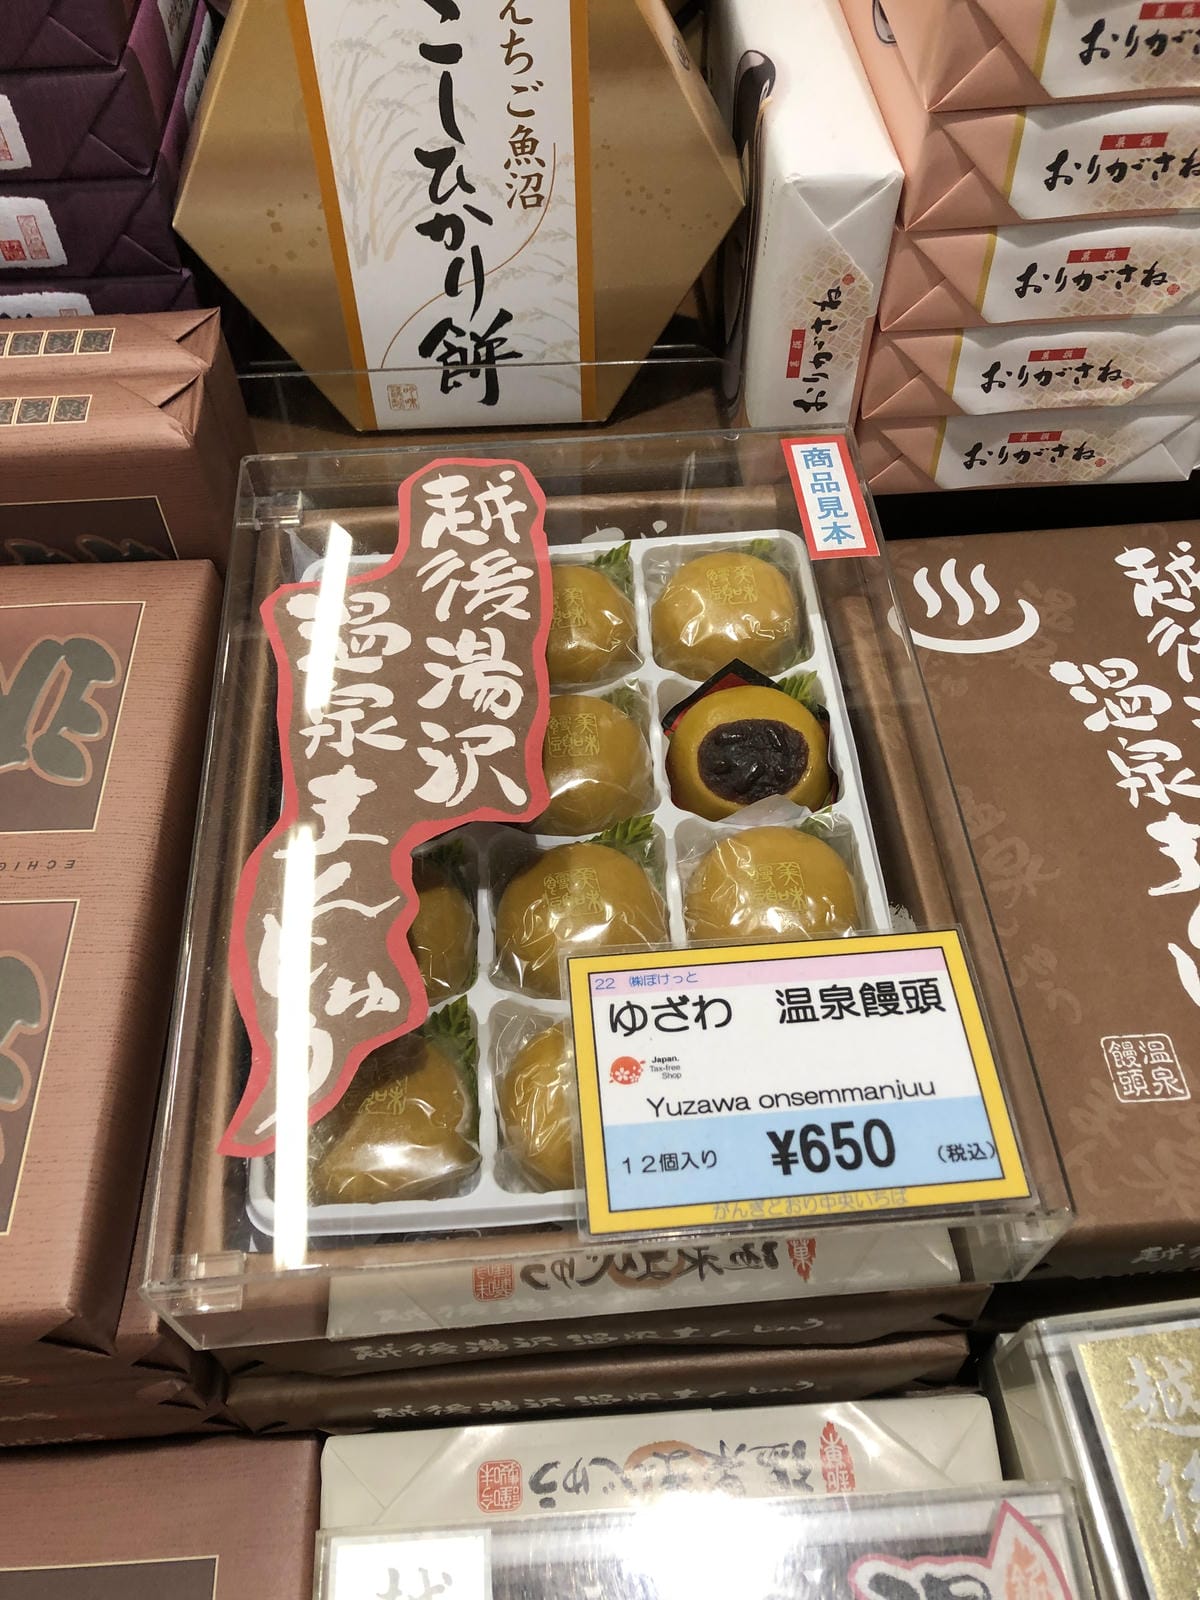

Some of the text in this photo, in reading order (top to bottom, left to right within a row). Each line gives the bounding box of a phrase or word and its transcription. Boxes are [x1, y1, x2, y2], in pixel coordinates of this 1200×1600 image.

[1015, 260, 1168, 299] おりがさね
[793, 286, 842, 412] おりがさね
[981, 359, 1122, 393] おりがさね
[963, 441, 1096, 470] おりがさね
[800, 447, 856, 545] 商品見本
[405, 470, 534, 808] 越後湯沢
[595, 977, 616, 990] 22
[609, 977, 946, 1037] ゆざわ 温泉饅頭
[650, 1063, 681, 1074] Tax-free
[661, 1072, 682, 1081] Shop
[646, 1079, 936, 1118] Yuzawa onsemmanjuu
[766, 1118, 896, 1176] ¥650
